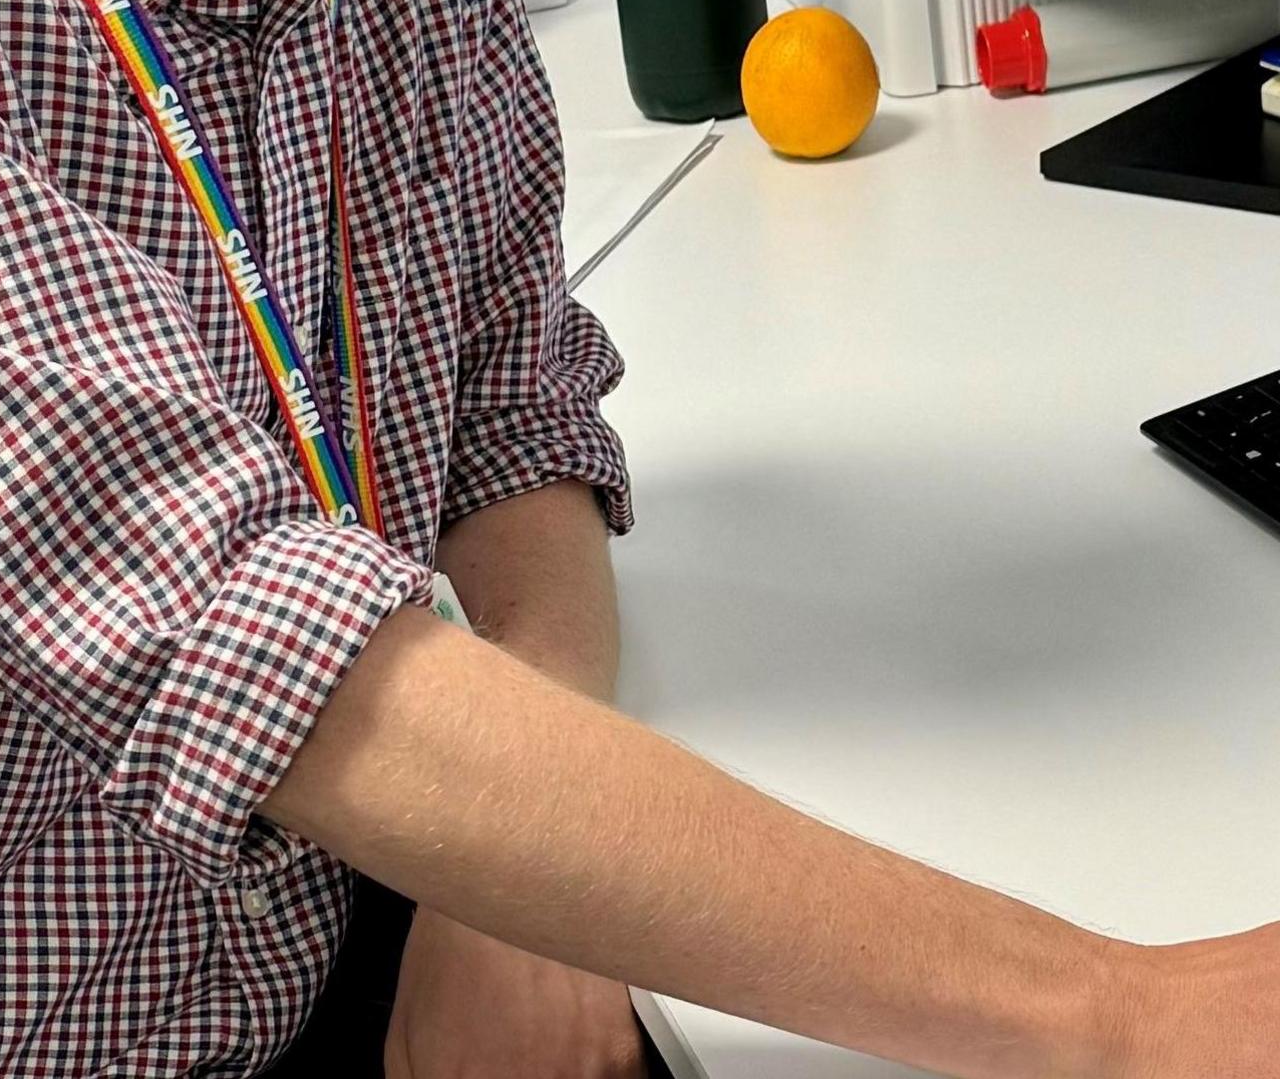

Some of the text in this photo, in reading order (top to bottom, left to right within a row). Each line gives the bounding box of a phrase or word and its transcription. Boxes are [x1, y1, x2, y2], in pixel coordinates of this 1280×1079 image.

[146, 83, 204, 162] NHS
[216, 227, 268, 304] NHS
[280, 368, 327, 441] NHS
[338, 374, 363, 456] NHS
